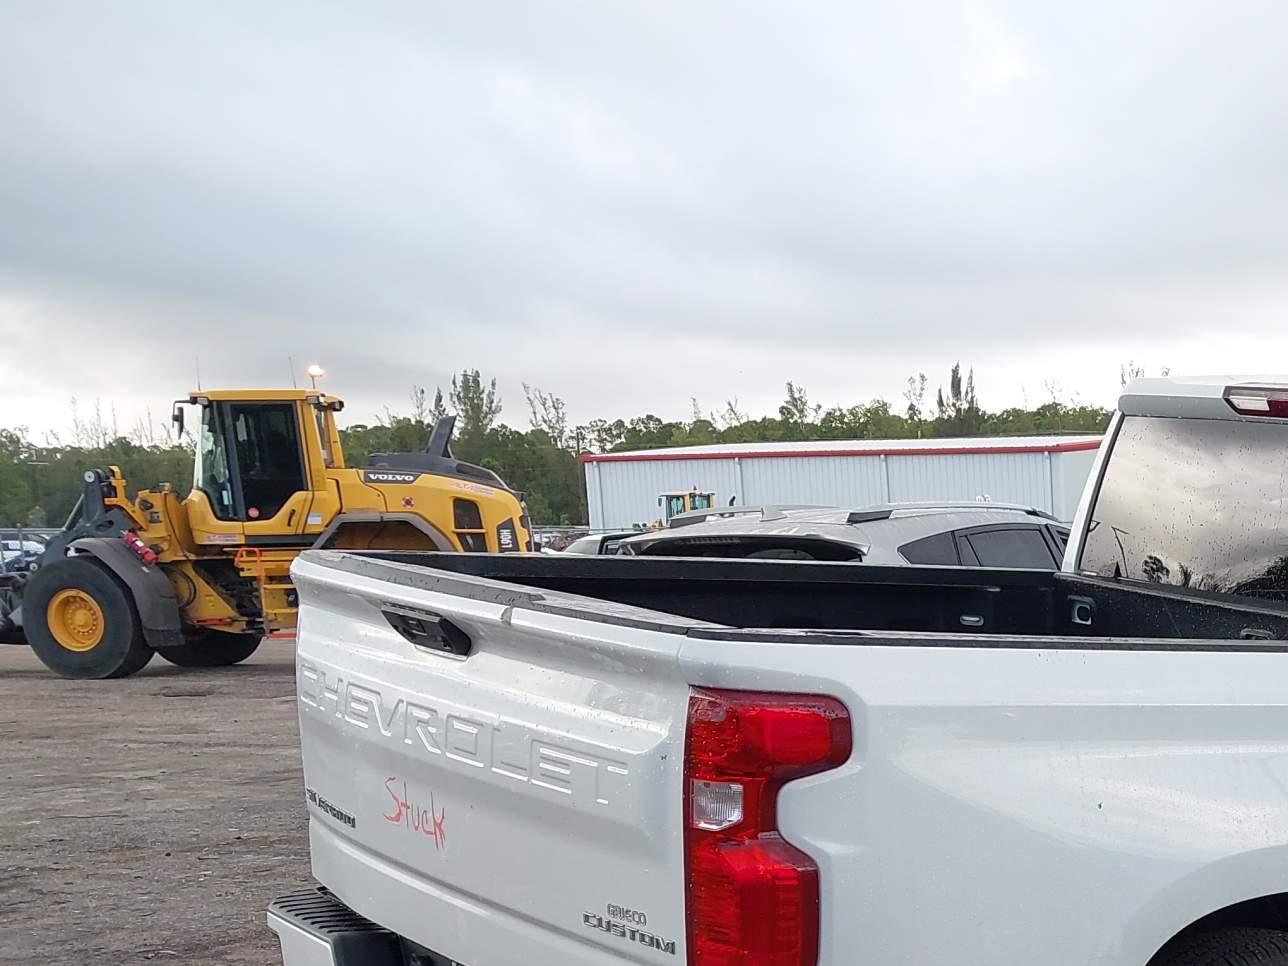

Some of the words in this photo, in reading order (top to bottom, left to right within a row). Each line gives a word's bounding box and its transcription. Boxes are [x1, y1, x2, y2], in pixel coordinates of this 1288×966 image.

[368, 473, 415, 482] VOLVO
[499, 529, 513, 548] L90H
[300, 663, 629, 805] CHEVROLET
[582, 911, 676, 955] CUSTOM
